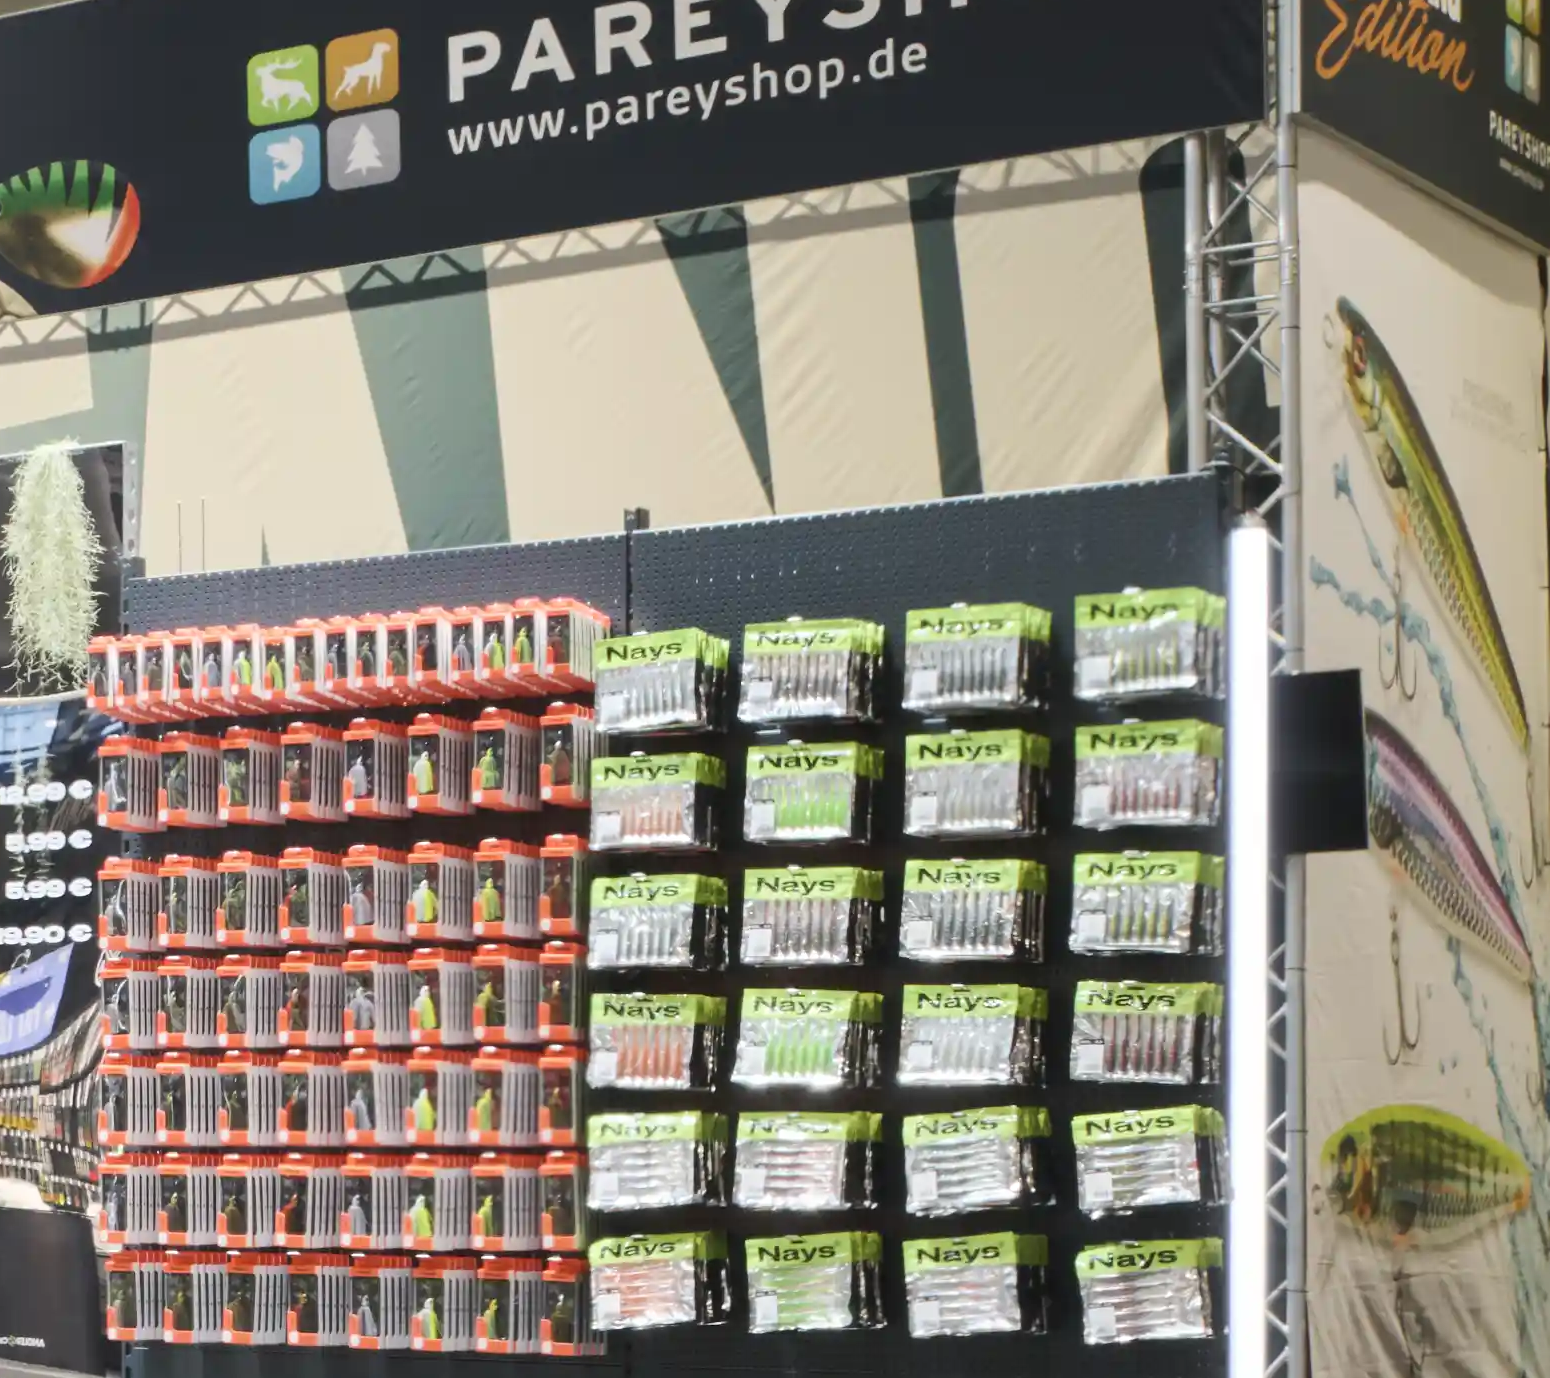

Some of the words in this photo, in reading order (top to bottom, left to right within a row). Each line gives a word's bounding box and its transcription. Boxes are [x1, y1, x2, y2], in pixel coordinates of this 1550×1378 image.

[448, 38, 929, 155] www.pareyshop.de
[1090, 602, 1178, 620] Nays
[757, 630, 837, 650] Nays
[606, 641, 682, 663] Nays
[1090, 731, 1178, 751] Nays
[759, 751, 838, 770] Nays
[919, 741, 1003, 762] Nays
[603, 762, 680, 780] Nays
[917, 867, 1001, 886] Nays
[1088, 860, 1178, 879] Nays
[603, 883, 678, 902] Nays
[756, 875, 836, 895] Nays
[603, 999, 680, 1018] Nays
[753, 995, 833, 1015] Nays
[917, 993, 1002, 1012] Nays
[1086, 990, 1175, 1009] Nays
[915, 1119, 998, 1137] Nays
[1086, 1115, 1174, 1136] Nays
[599, 1241, 676, 1258] Nays
[758, 1244, 836, 1263] Nays
[917, 1245, 1001, 1264] Nays
[1089, 1248, 1177, 1269] Nays
